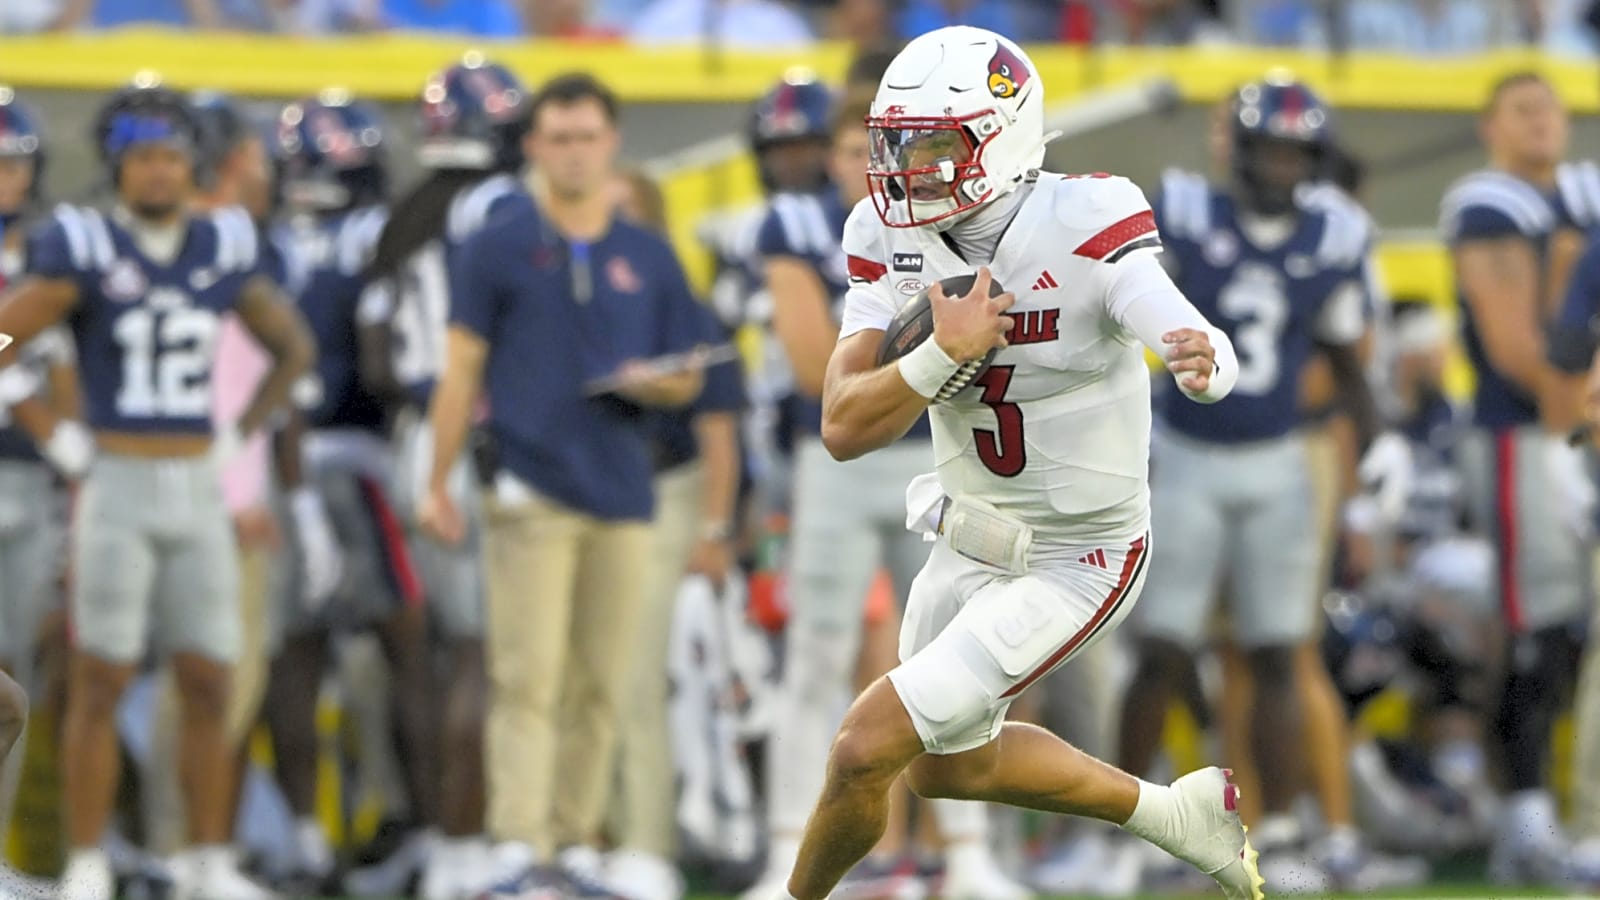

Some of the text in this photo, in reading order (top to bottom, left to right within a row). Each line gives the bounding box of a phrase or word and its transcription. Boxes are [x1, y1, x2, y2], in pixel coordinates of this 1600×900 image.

[901, 282, 921, 290] ACC
[1217, 282, 1288, 396] 3
[114, 309, 217, 417] 12
[972, 364, 1027, 477] 3
